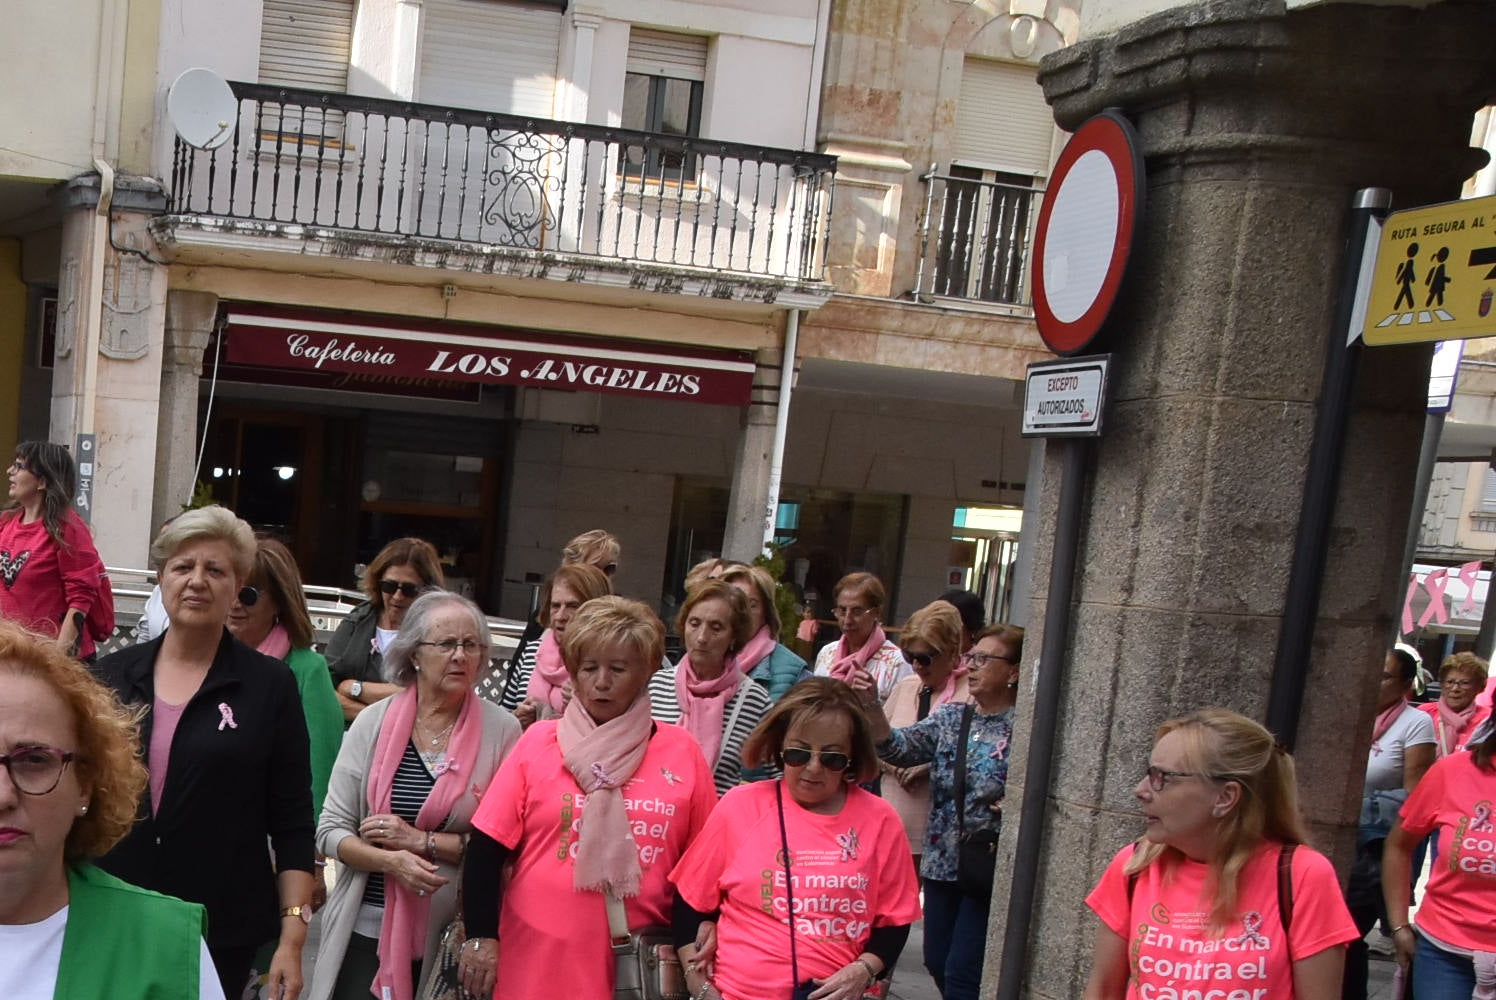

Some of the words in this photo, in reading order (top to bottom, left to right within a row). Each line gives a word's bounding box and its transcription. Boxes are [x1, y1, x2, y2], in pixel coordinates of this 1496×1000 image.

[1391, 227, 1418, 241] RUTA
[1423, 219, 1466, 236] SEGURA
[1472, 216, 1486, 229] AL
[286, 333, 397, 369] Cafetería
[425, 350, 512, 377] LOS
[520, 358, 701, 395] ANGELES
[1047, 375, 1079, 393] EXCEPTO
[1038, 398, 1085, 415] AUTORIZADOS
[624, 798, 676, 817] archa
[773, 894, 850, 914] contra
[1145, 926, 1173, 949] En
[1139, 956, 1232, 981] contra
[1238, 956, 1267, 979] el
